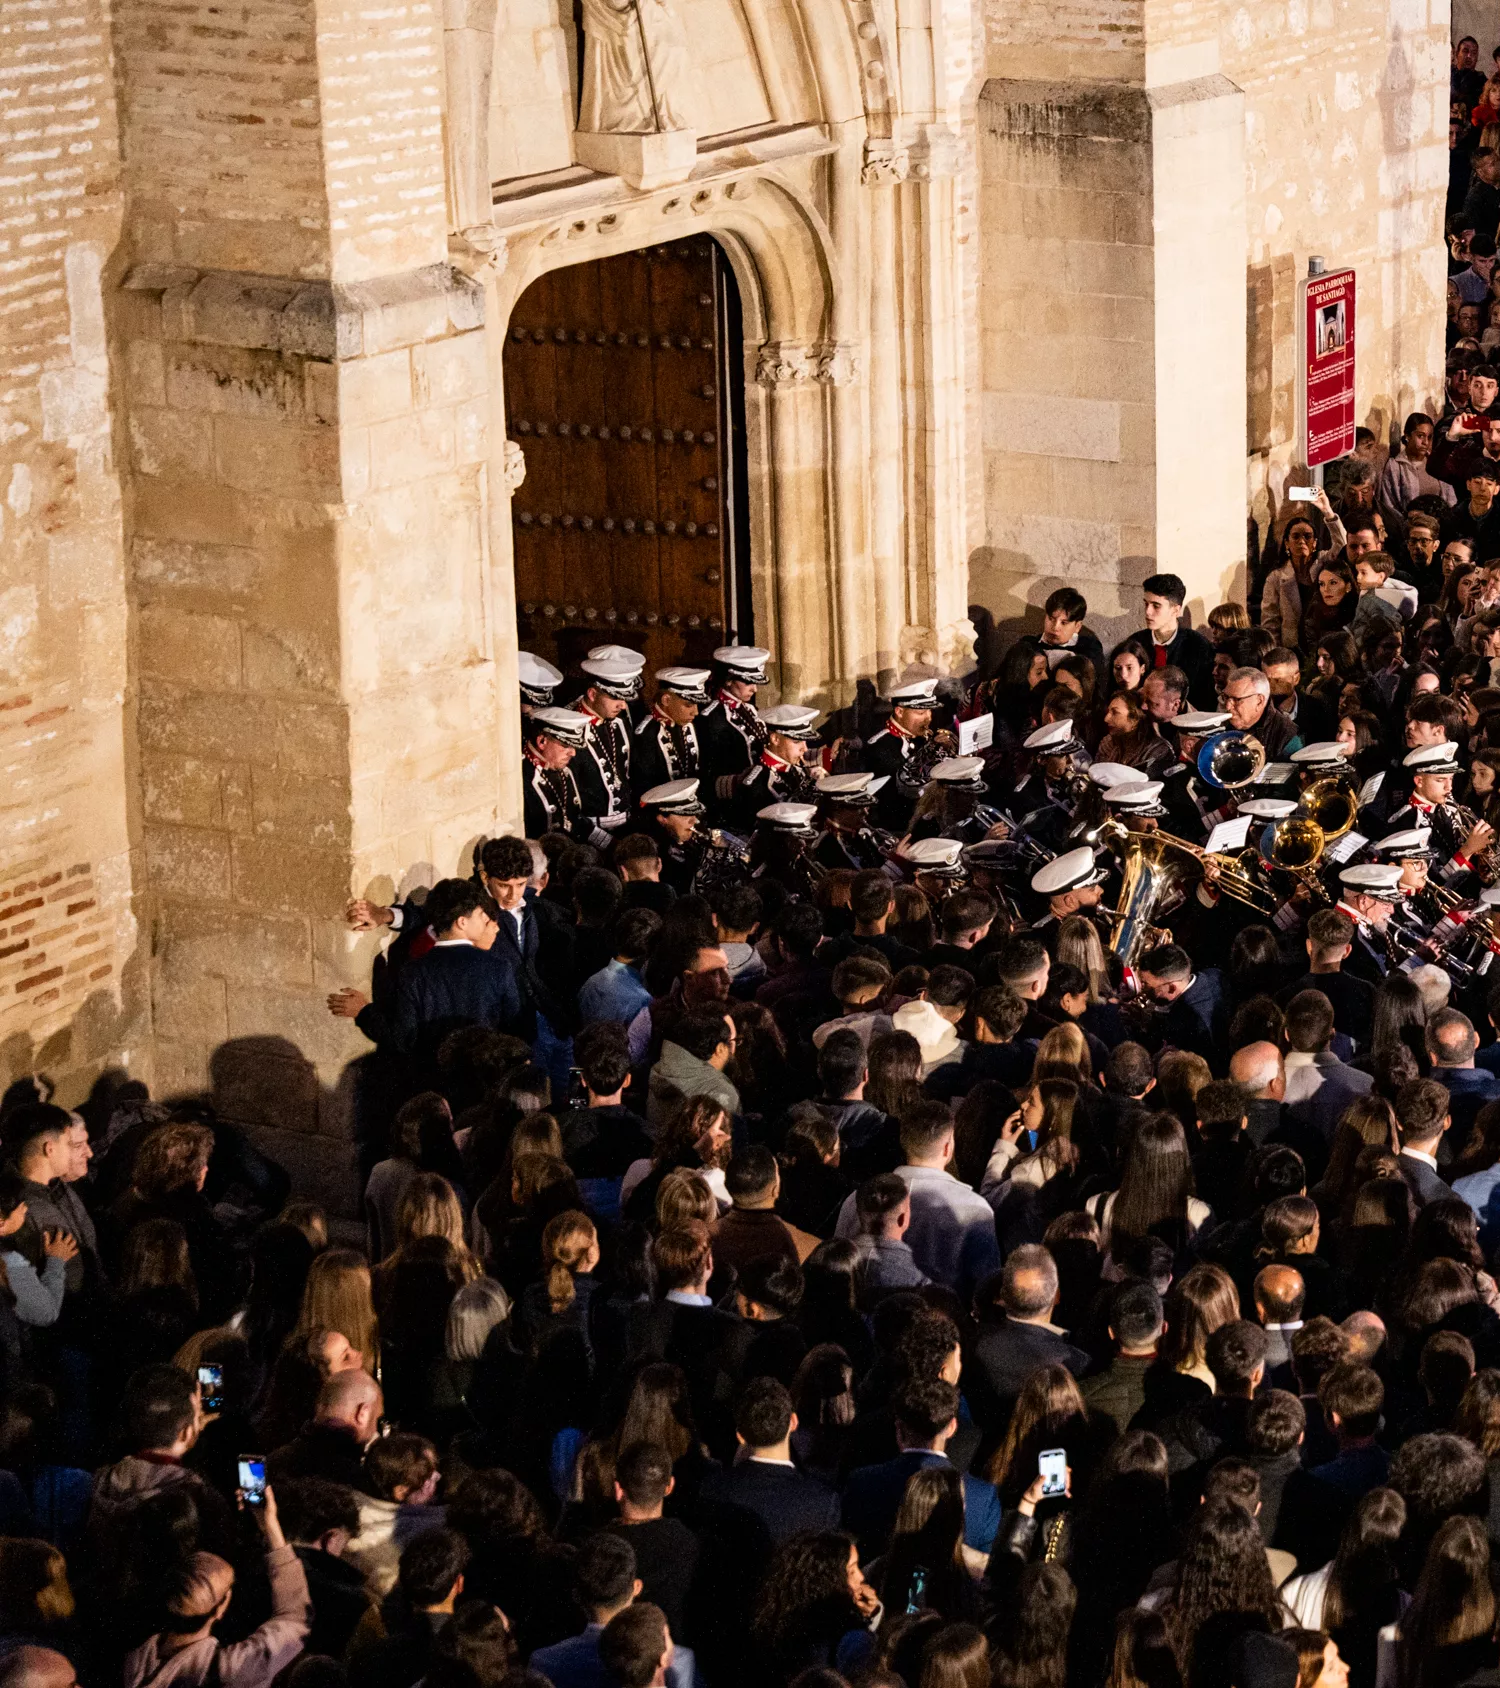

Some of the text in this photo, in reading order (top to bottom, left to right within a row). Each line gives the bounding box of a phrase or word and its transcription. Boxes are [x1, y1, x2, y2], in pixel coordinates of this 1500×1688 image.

[1307, 273, 1354, 297] IGLESIA PARROQUIAL
[1316, 286, 1346, 305] DE SANTIAGO
